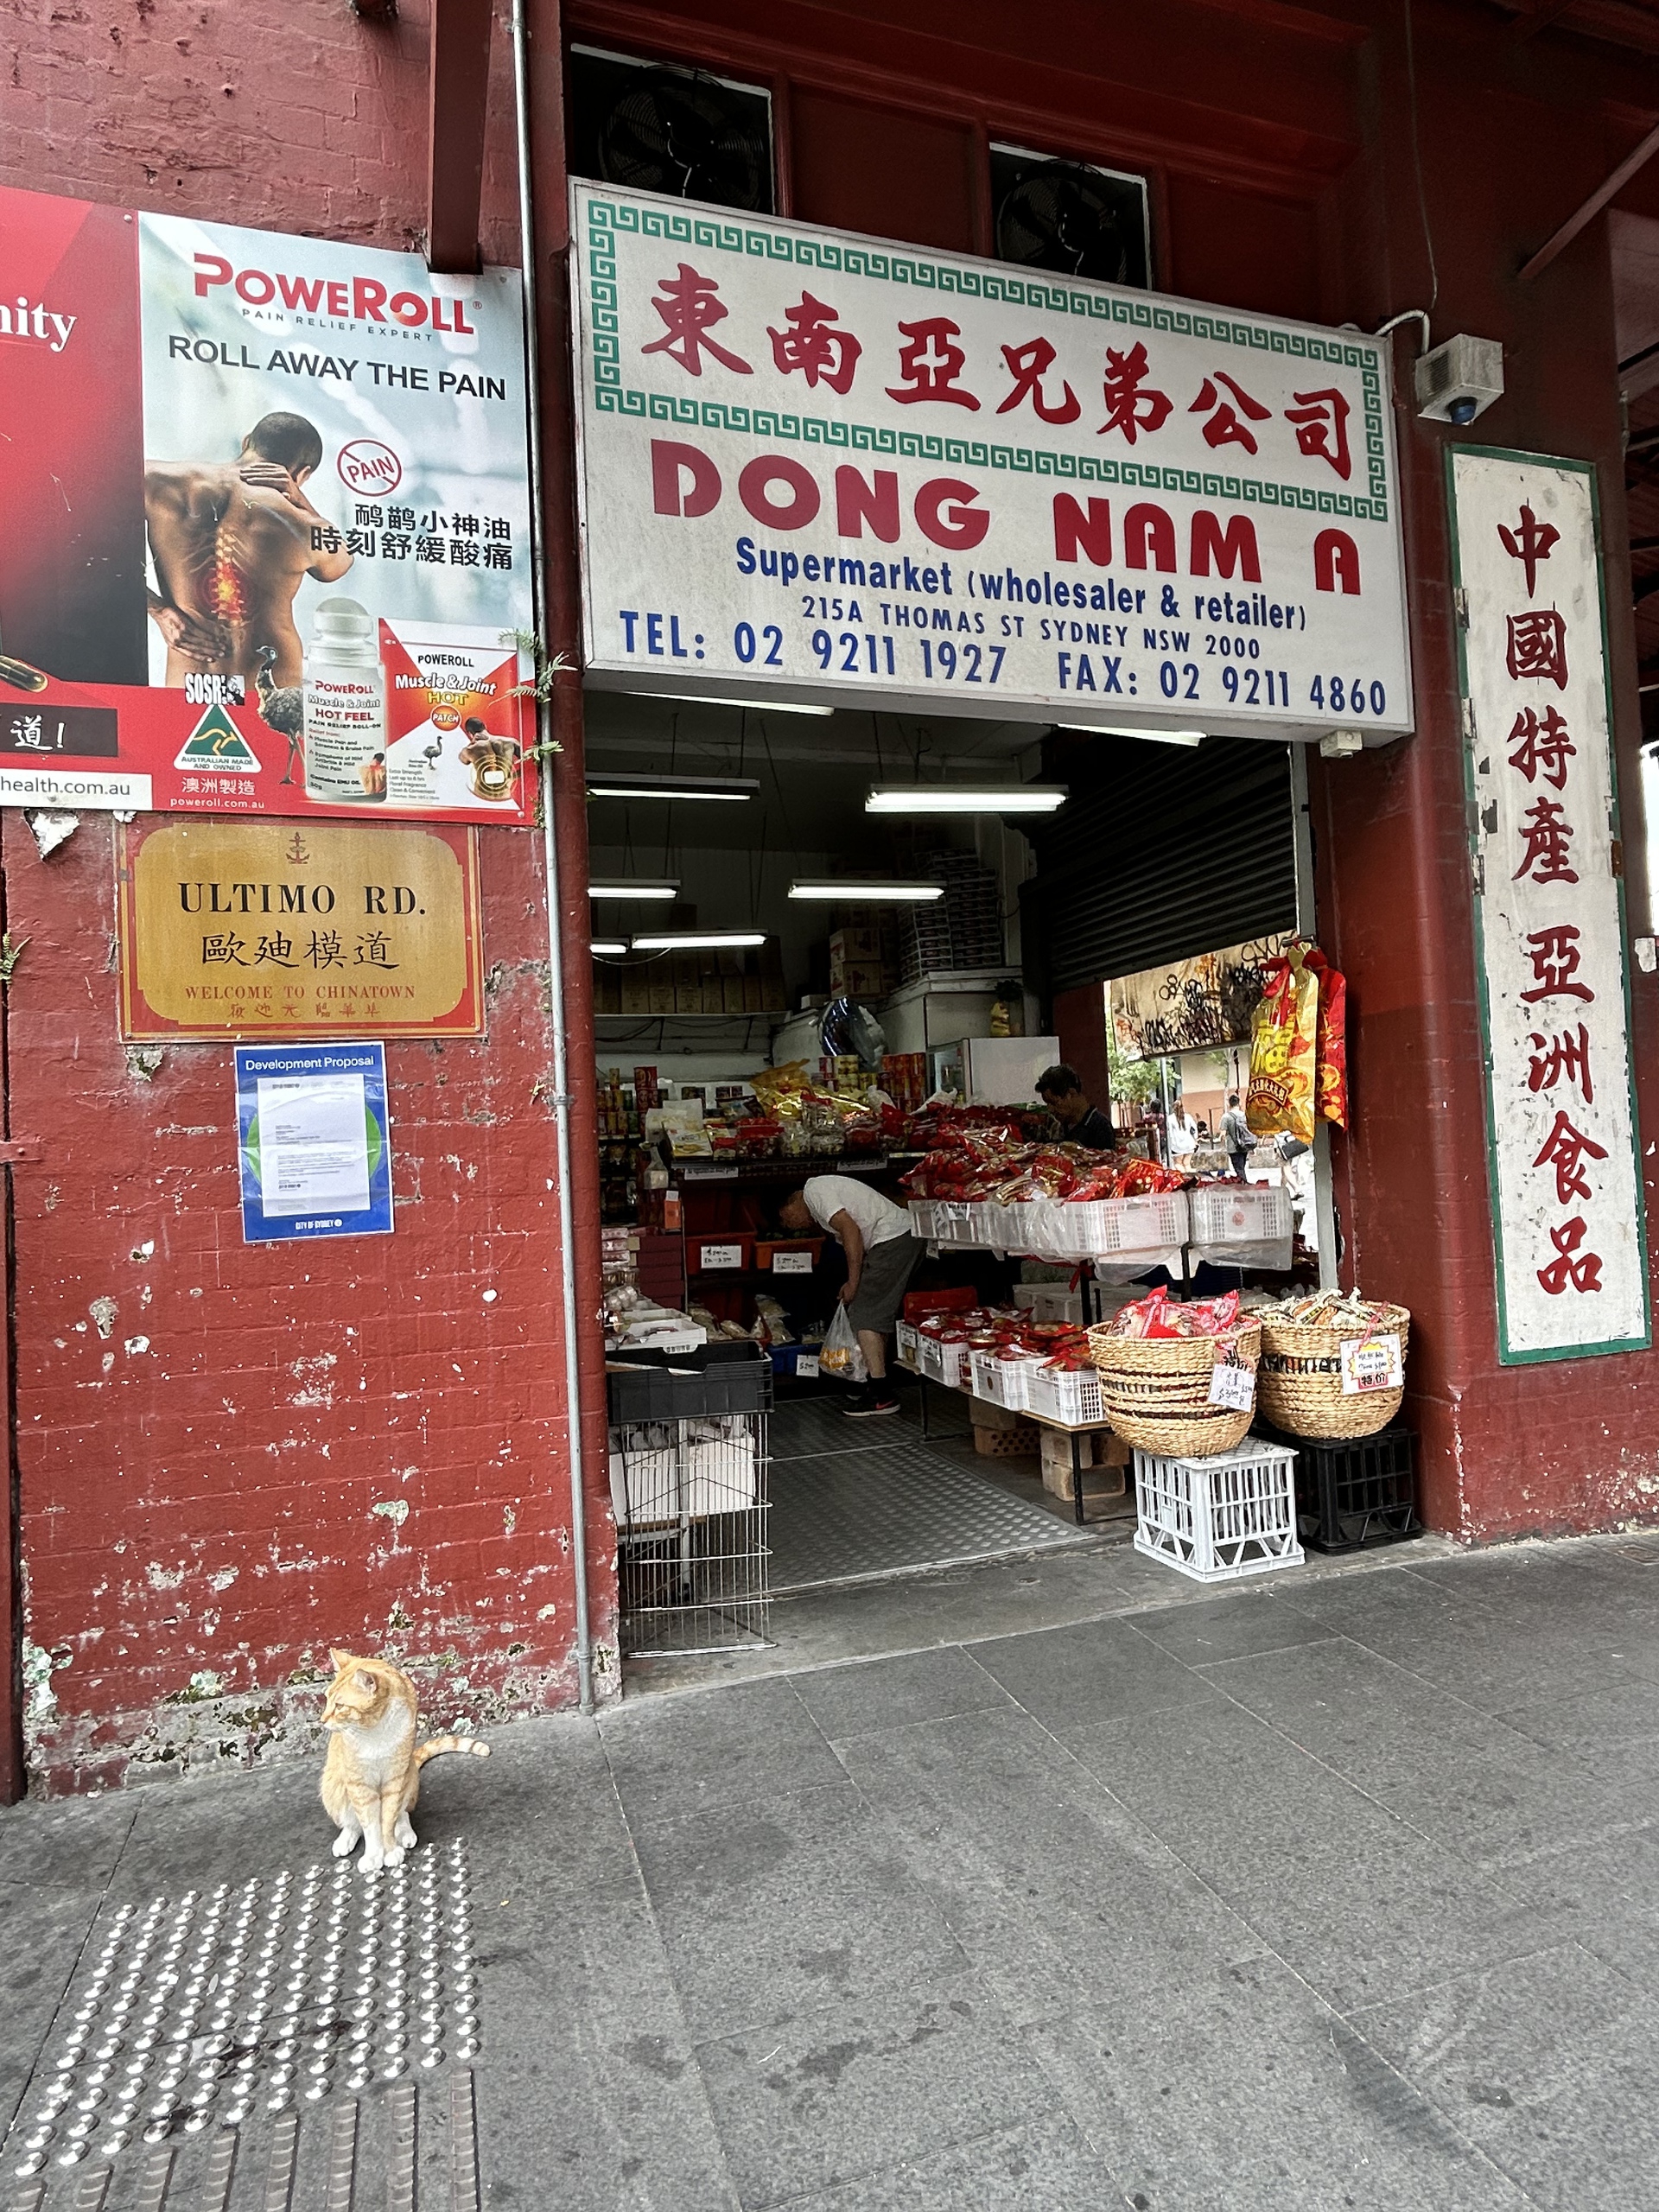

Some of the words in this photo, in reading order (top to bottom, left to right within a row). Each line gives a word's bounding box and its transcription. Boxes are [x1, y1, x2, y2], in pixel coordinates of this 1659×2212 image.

[242, 308, 284, 321] PAIN
[296, 316, 357, 332] RELIEF
[368, 326, 432, 341] EXPERT
[168, 335, 260, 370] ROLL
[267, 349, 359, 381] AWAY
[366, 361, 429, 391] THE
[439, 371, 506, 401] PAIN
[641, 263, 1351, 480] 東南亞兄弟公司
[346, 455, 395, 484] PAIN
[651, 439, 989, 550] DONG
[1052, 492, 1262, 583] NAM
[1314, 529, 1362, 595] A
[310, 525, 513, 571] 時刻舒緩酸痛
[736, 537, 953, 595] Supermarket
[968, 568, 1146, 618] (wholesaler
[1160, 583, 1180, 618] &
[1194, 594, 1306, 631] retailer)
[802, 595, 862, 623] 215A
[880, 603, 984, 634] THOMAS
[1001, 614, 1024, 638] ST
[1041, 619, 1128, 647] SYDNEY
[1144, 628, 1190, 653] NSW
[1205, 634, 1260, 659] 2000
[418, 654, 474, 667] POWEROLL
[620, 610, 705, 659] TEL:
[734, 621, 784, 665] 02
[812, 629, 895, 675] 9211
[920, 639, 1006, 683] 1927
[1058, 652, 1138, 696] FAX:
[1160, 661, 1200, 701] 02
[1222, 666, 1290, 707] 9211
[1310, 675, 1386, 715] 4860
[395, 673, 445, 690] Muscle
[446, 675, 460, 690] &
[459, 676, 498, 696] Joint
[427, 691, 468, 705] HOT
[308, 694, 345, 709] Muscle
[346, 699, 355, 709] &
[355, 698, 381, 709] Joint
[315, 709, 342, 721] HOT
[345, 712, 374, 721] FEEL
[433, 713, 460, 723] PATCH
[181, 777, 255, 796] 澳洲製造
[170, 798, 265, 810] poweroll.com.au
[178, 882, 336, 914] ULTIMO
[364, 886, 426, 915] RD.
[1497, 504, 1609, 1294] 中國特產亞洲食品
[185, 986, 273, 1000] WELCOME
[283, 986, 305, 998] TO
[316, 985, 416, 999] CHINATOWN
[245, 1058, 322, 1071] Development
[324, 1055, 374, 1070] Proposal
